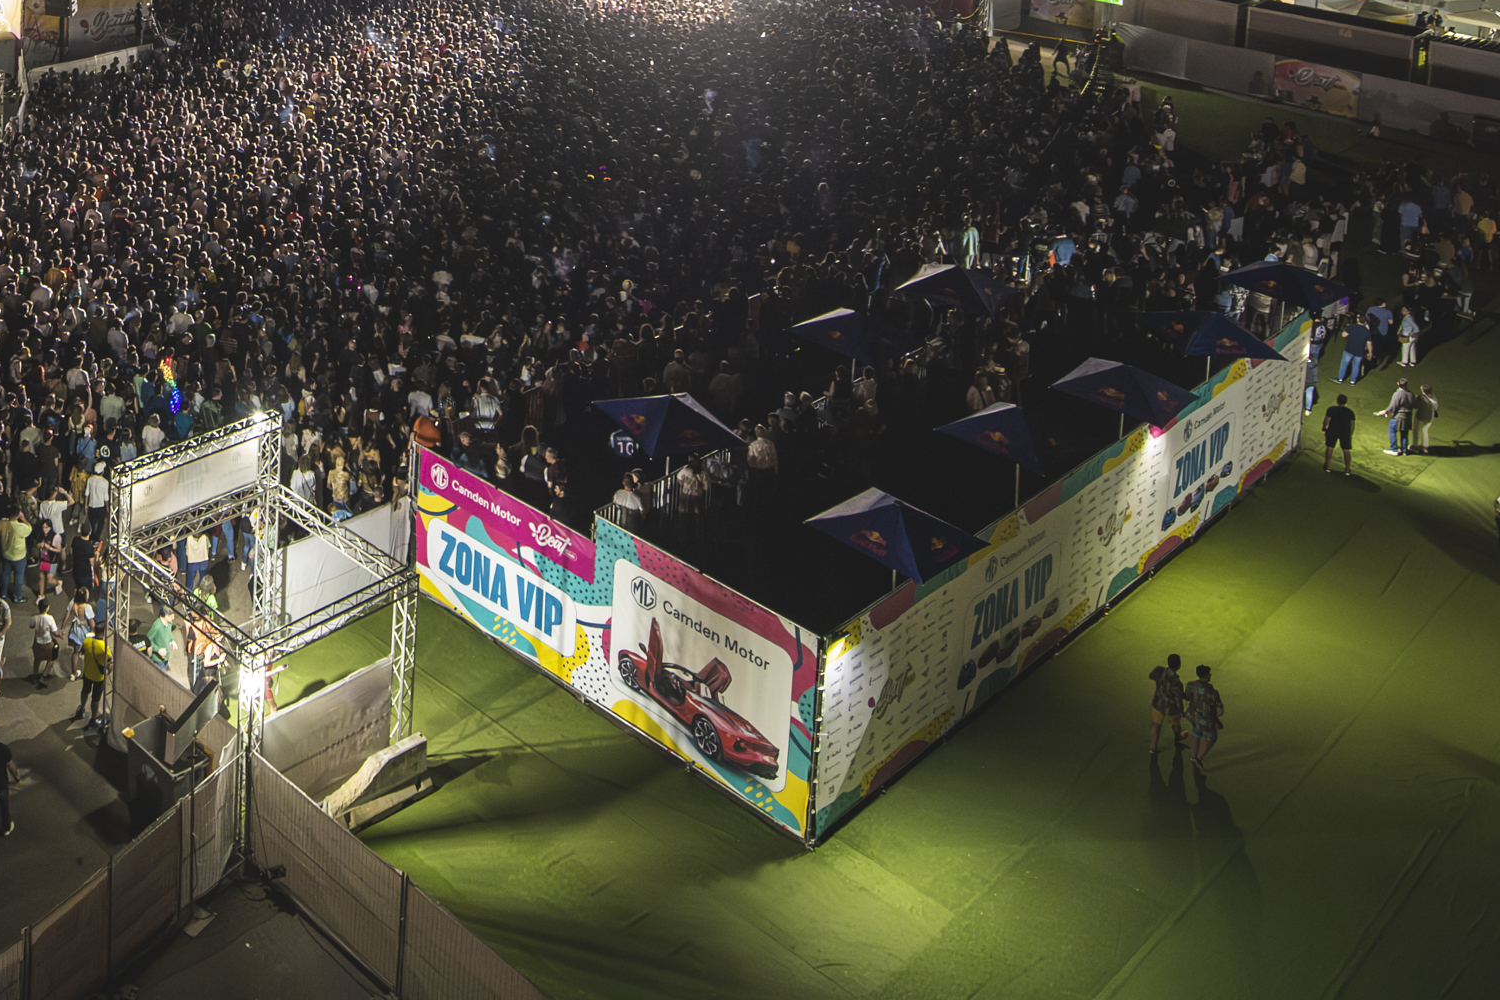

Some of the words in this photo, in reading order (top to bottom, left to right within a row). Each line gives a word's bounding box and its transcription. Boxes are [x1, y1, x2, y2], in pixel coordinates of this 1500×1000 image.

[451, 480, 489, 509] Camden
[490, 502, 522, 527] Motor
[1173, 439, 1207, 499] ZONA
[1209, 421, 1230, 470] VIP
[439, 530, 509, 611] ZONA
[516, 574, 563, 637] VIP
[632, 578, 656, 608] MG
[663, 600, 720, 644] Camden
[724, 634, 770, 670] Motor
[970, 577, 1019, 650] ZONA
[1024, 553, 1053, 611] VIP
